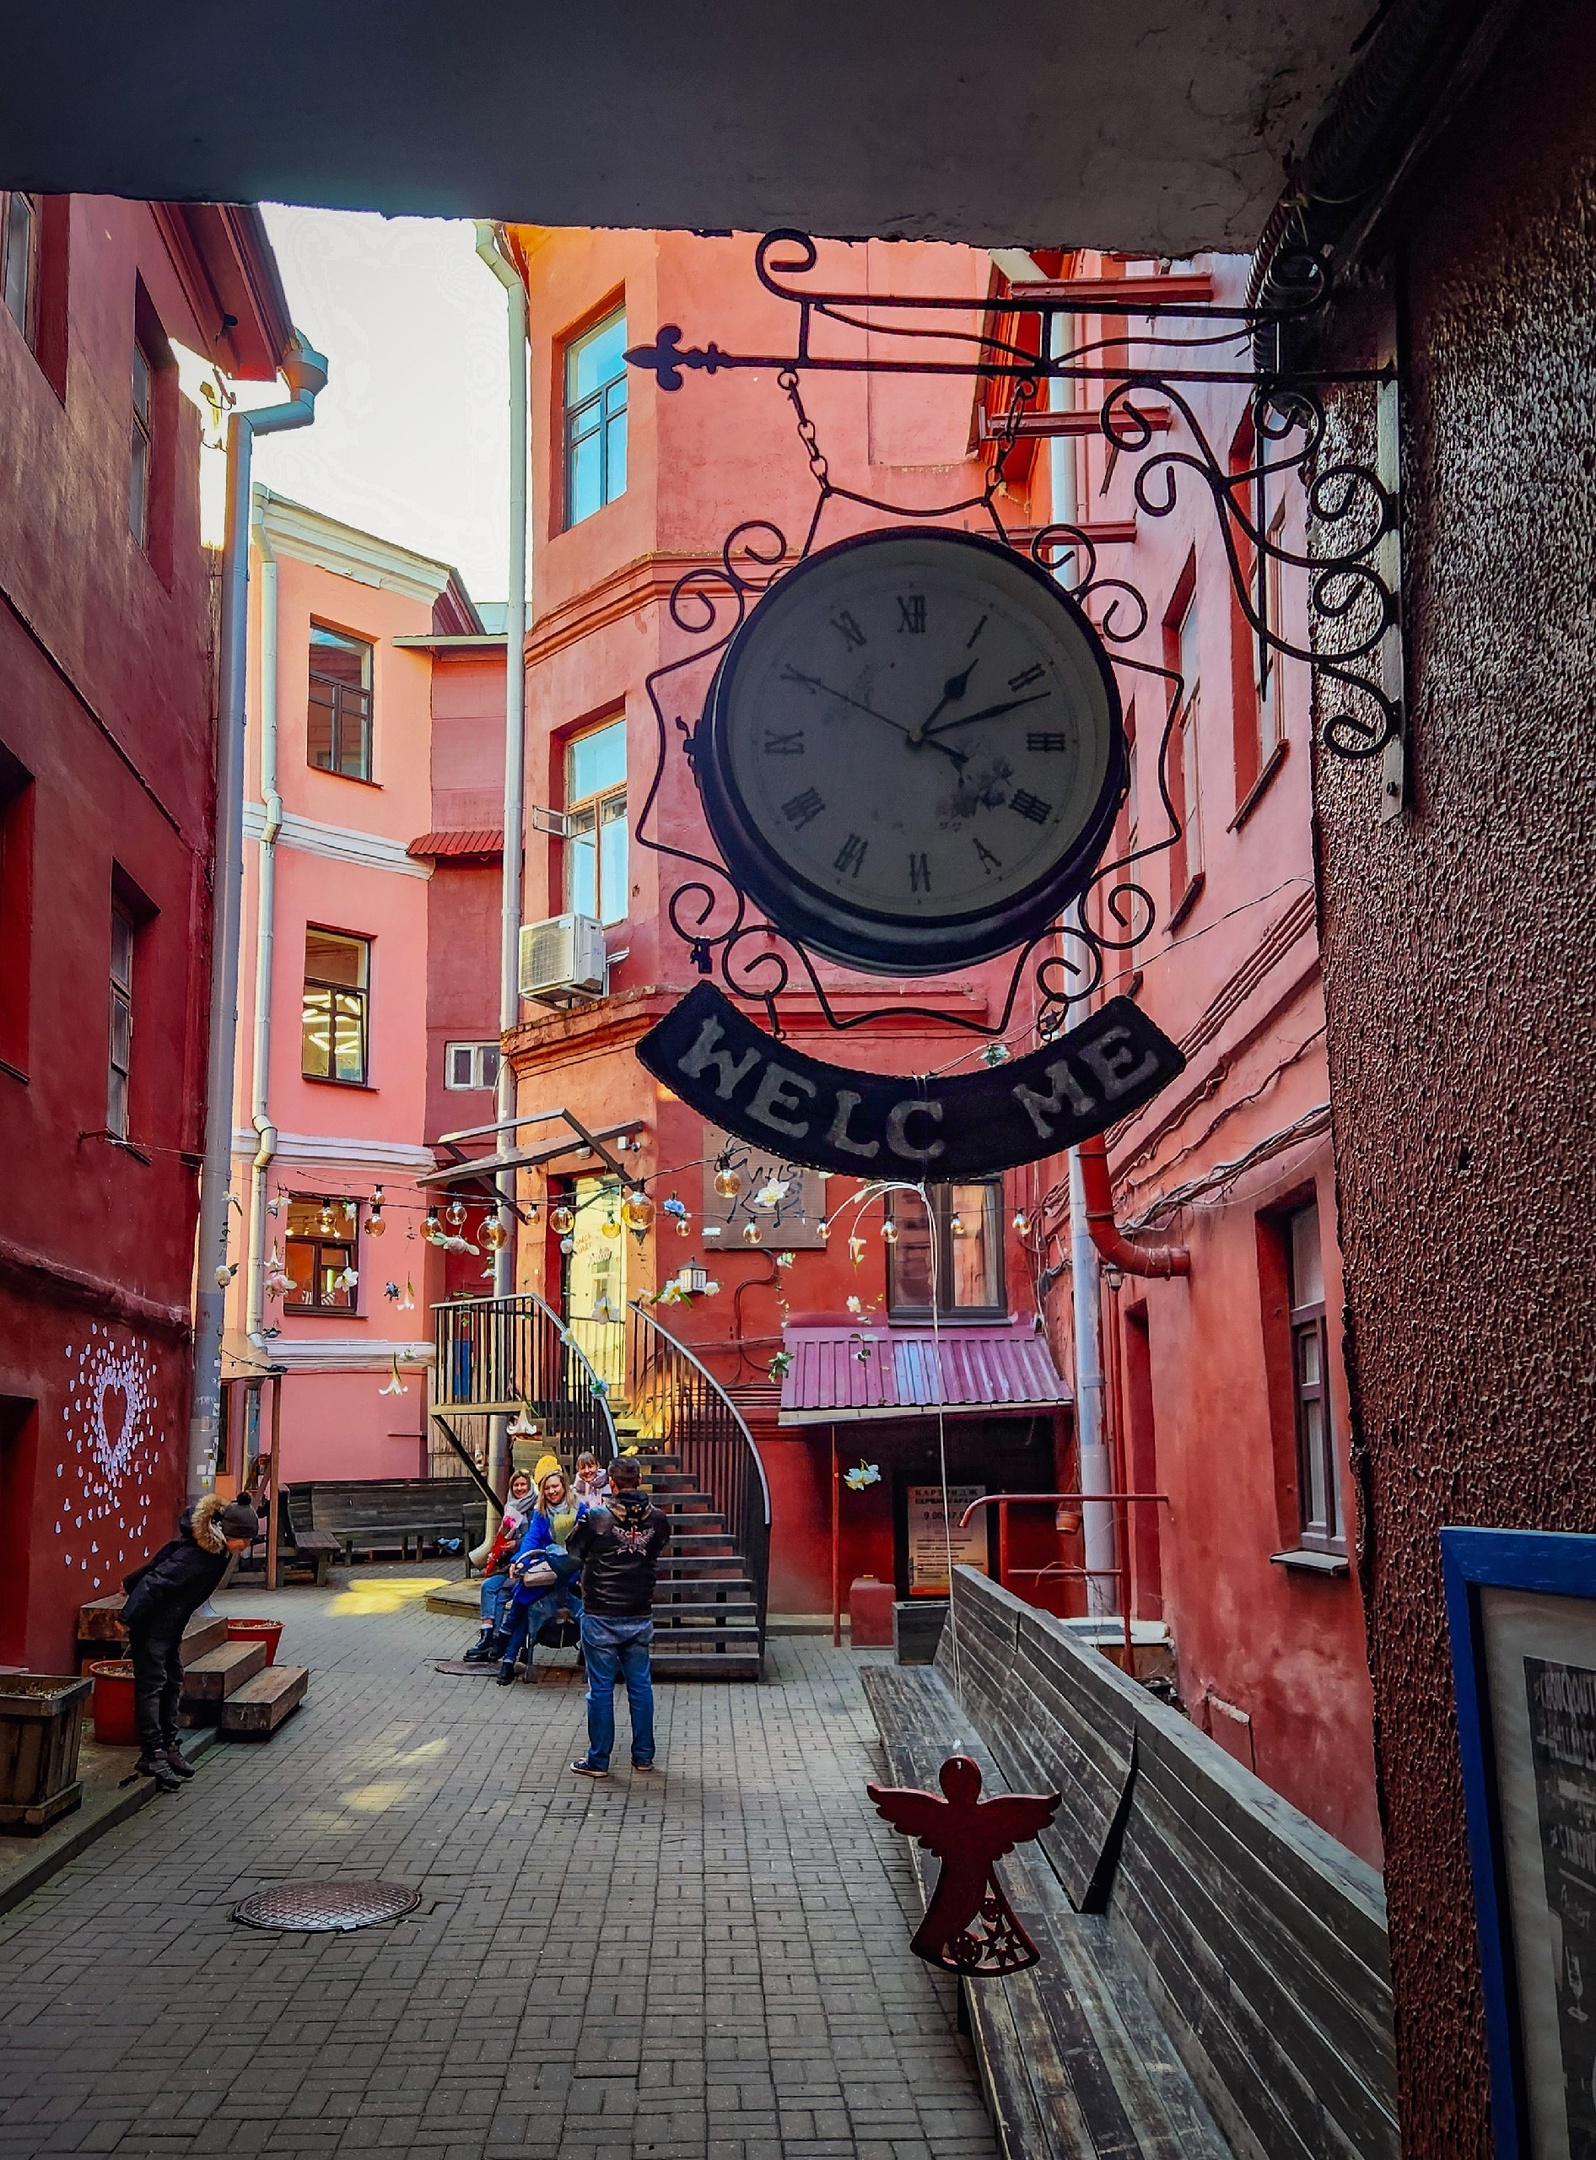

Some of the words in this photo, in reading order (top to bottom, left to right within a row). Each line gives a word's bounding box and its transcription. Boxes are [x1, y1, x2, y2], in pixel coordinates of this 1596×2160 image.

[830, 610, 866, 652] XI
[896, 594, 926, 633] XII
[966, 615, 988, 648] I
[1007, 663, 1045, 692] II
[1026, 731, 1066, 752] III
[833, 833, 868, 878] VII
[909, 853, 931, 892] VI
[972, 837, 1002, 874] V
